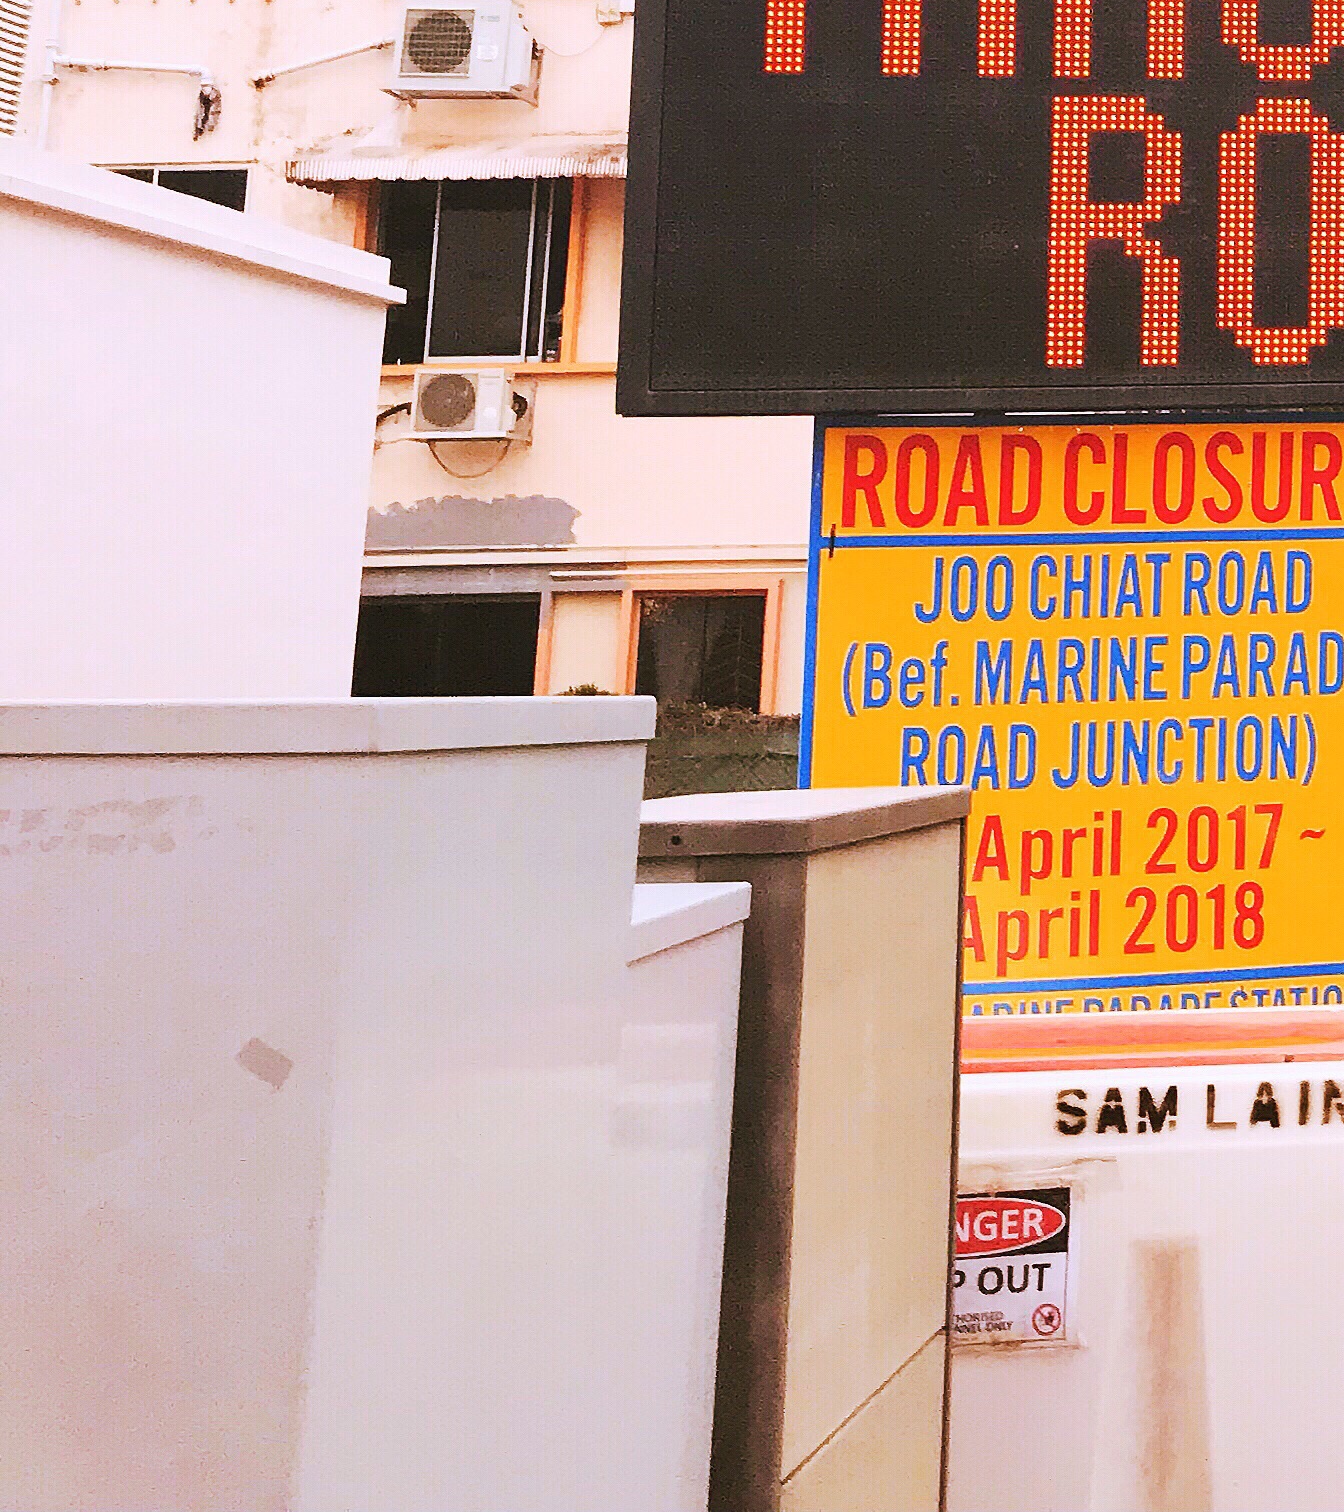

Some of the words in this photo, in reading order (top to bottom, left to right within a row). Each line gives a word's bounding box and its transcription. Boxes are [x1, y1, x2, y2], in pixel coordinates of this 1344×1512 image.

[841, 432, 1043, 529] ROAD
[914, 554, 1013, 623] JOO
[1030, 552, 1171, 619] CHIAT
[1183, 550, 1312, 616] ROAD
[842, 641, 960, 717] (Bef.
[975, 635, 1168, 705] MARINE
[901, 723, 1036, 789] ROAD
[1052, 714, 1317, 789] JUNCTION)
[971, 809, 1123, 896] April
[1145, 803, 1284, 874] 2017
[963, 889, 1100, 978] April
[1123, 881, 1265, 956] 2018
[1055, 1085, 1178, 1136] SAM
[956, 1207, 1044, 1242] NGER
[978, 1263, 1052, 1295] OUT
